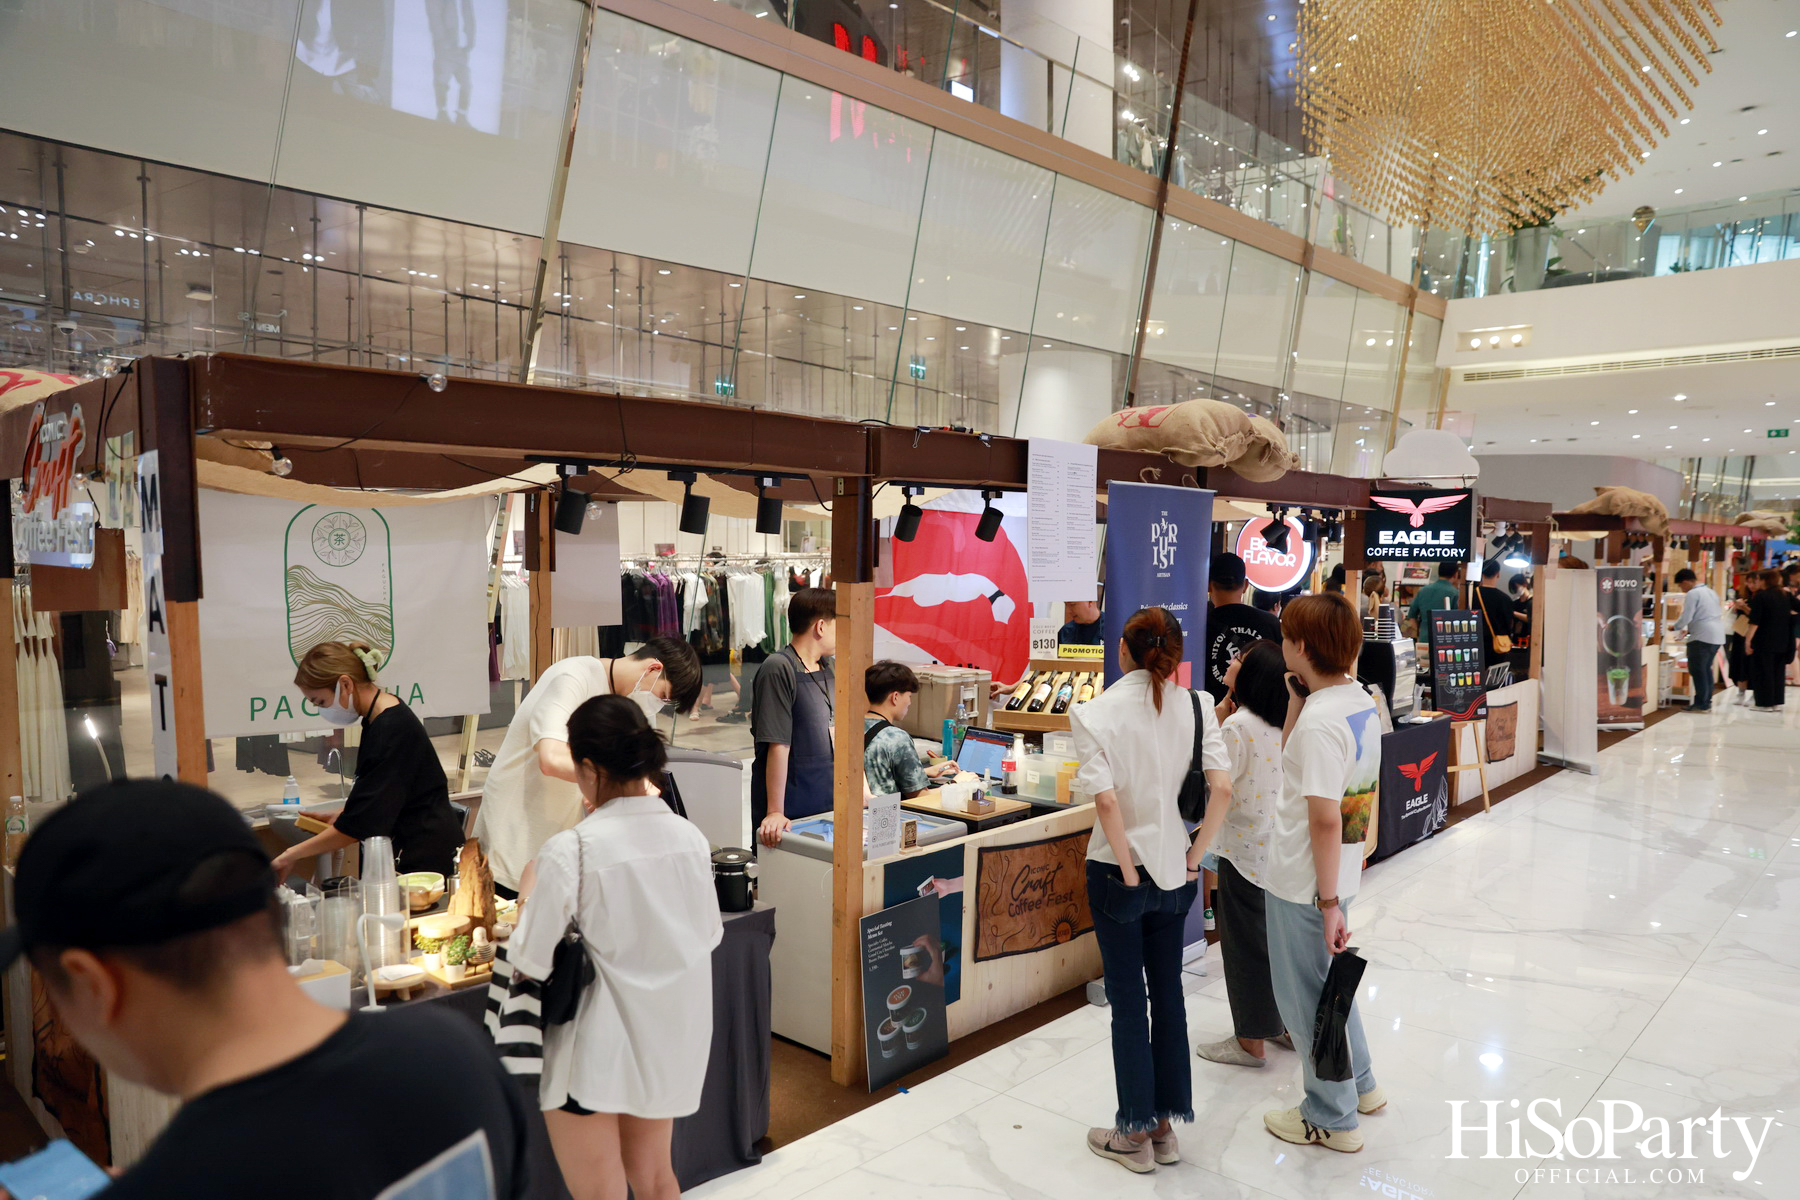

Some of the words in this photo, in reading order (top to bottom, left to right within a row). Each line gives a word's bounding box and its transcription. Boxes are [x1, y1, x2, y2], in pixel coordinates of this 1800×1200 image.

[334, 533, 346, 546] 茶
[1379, 531, 1455, 545] EAGLE
[1243, 550, 1296, 567] FLAVOR
[1367, 547, 1409, 557] COFFEE
[1413, 548, 1466, 558] FACTORY
[1614, 579, 1638, 588] KOYO
[1230, 626, 1258, 638] THAI
[1406, 793, 1429, 811] EAGLE
[1011, 861, 1064, 902] Craft
[1008, 898, 1042, 918] Coffee
[1047, 889, 1074, 907] Fest
